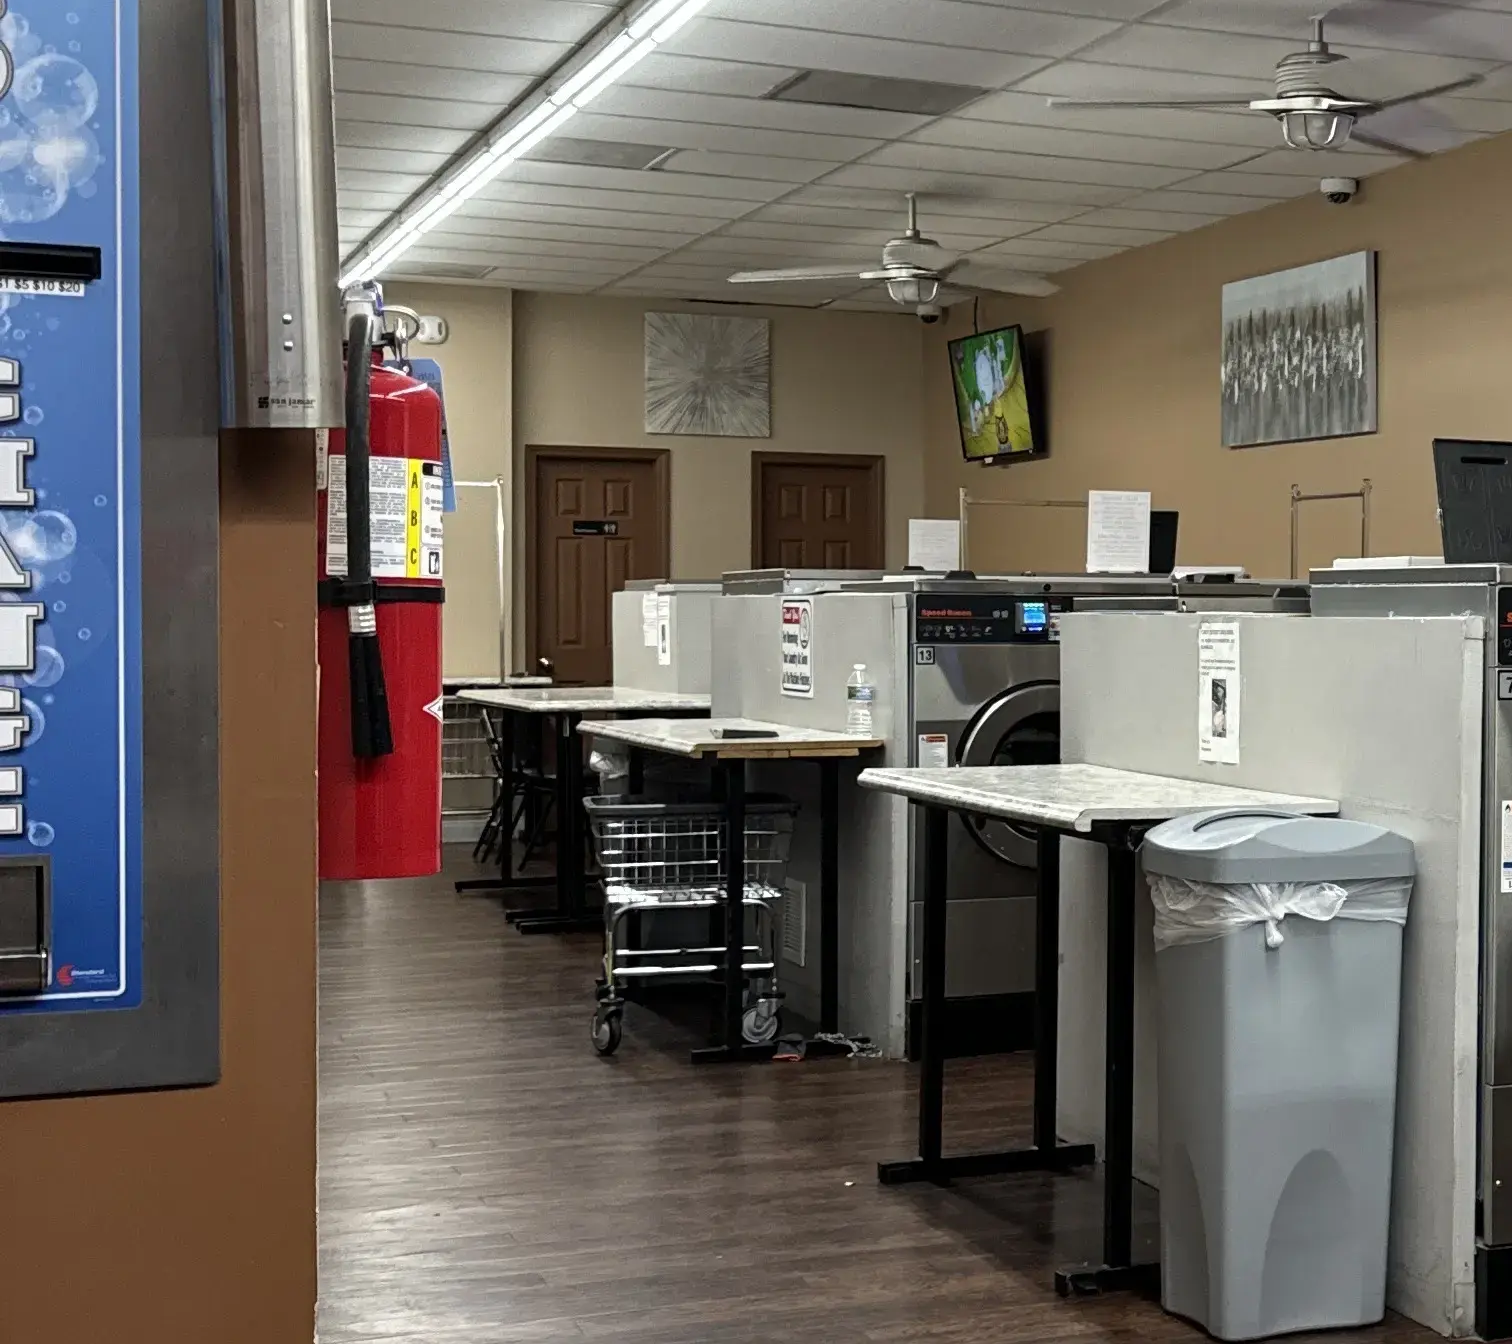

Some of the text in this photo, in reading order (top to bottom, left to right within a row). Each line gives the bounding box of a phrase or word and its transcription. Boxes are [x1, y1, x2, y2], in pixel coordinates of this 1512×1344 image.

[15, 278, 29, 290] $5
[33, 279, 55, 291] $10
[59, 280, 81, 293] $20
[410, 472, 419, 489] A
[410, 510, 418, 526] B
[410, 549, 417, 564] C
[919, 650, 933, 662] 13
